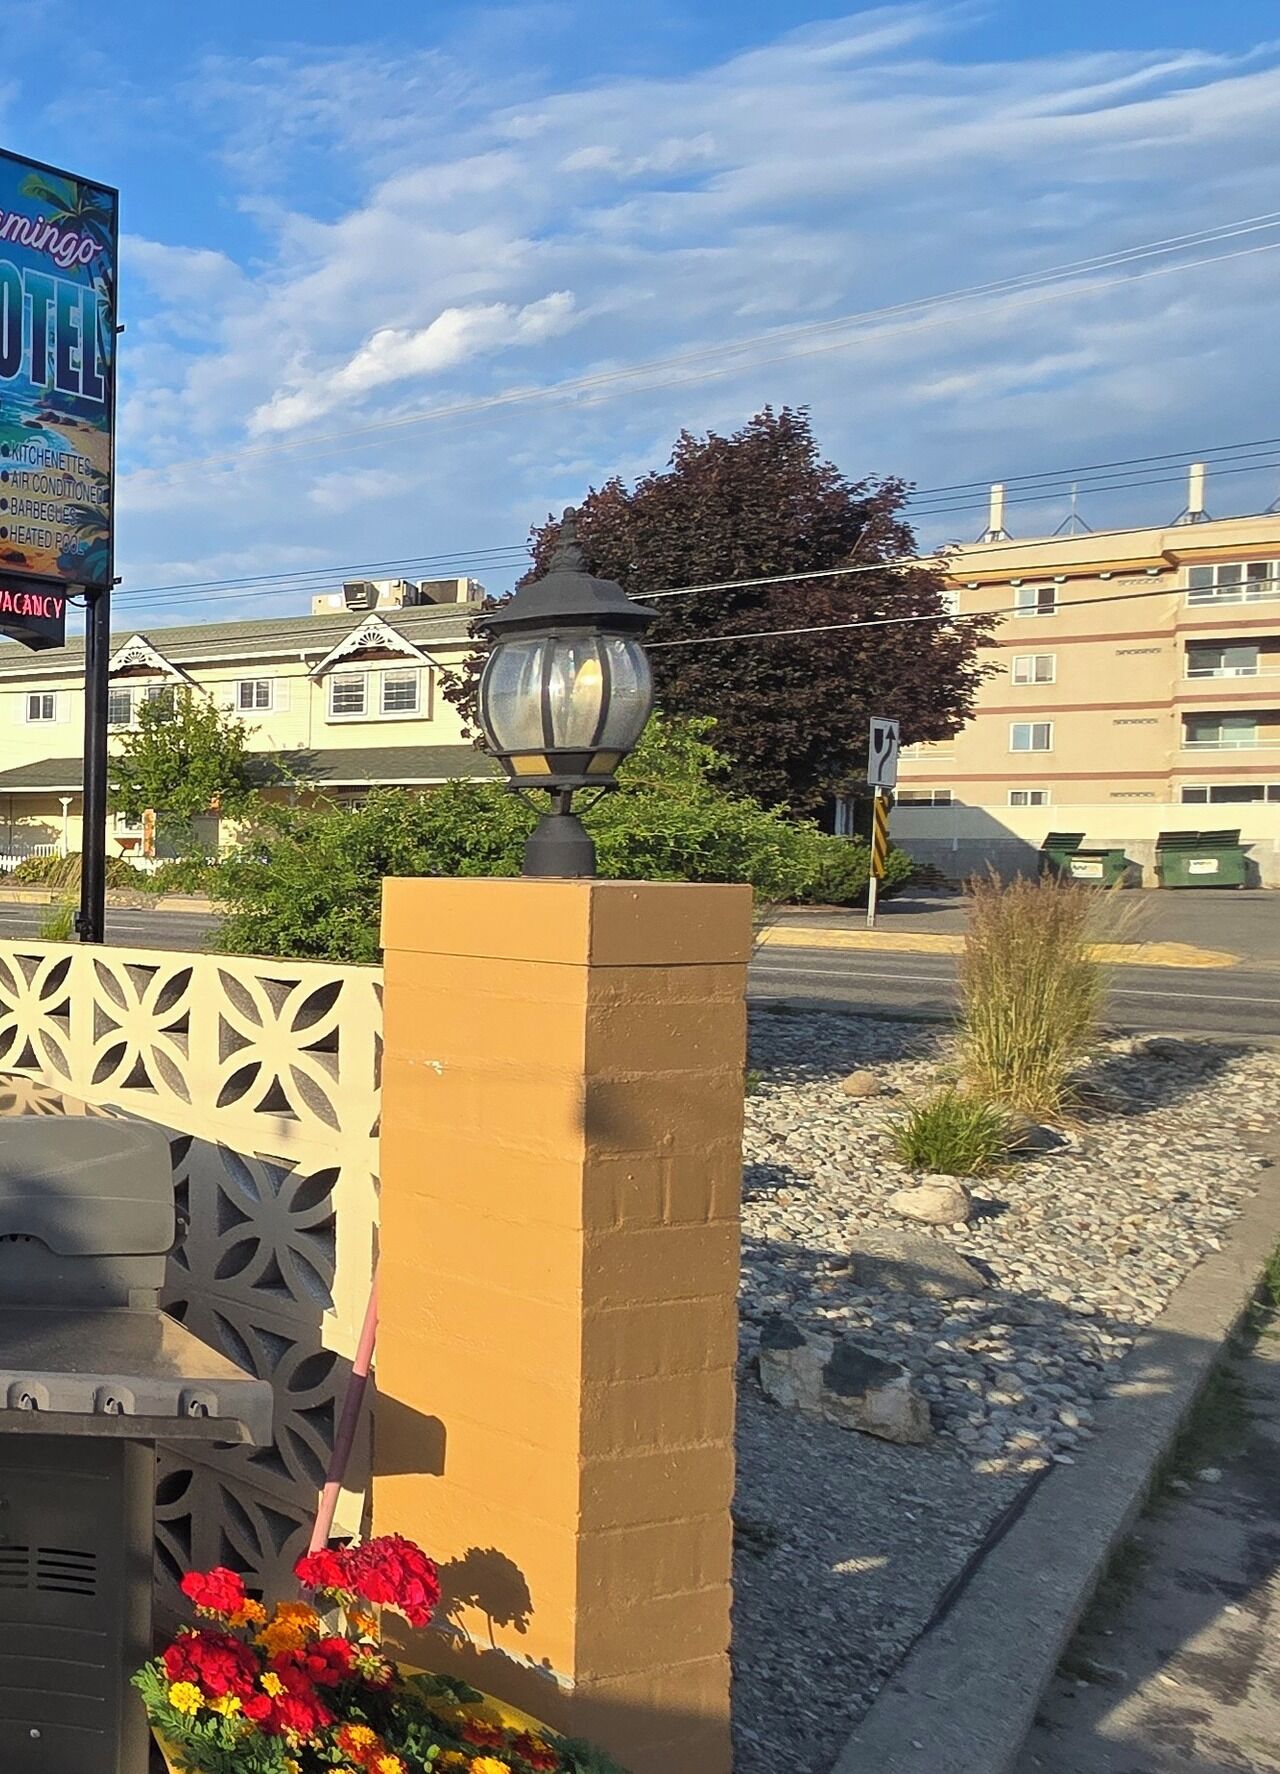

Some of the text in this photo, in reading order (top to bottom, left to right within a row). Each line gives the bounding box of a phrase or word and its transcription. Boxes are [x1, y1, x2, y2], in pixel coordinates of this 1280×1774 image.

[11, 443, 92, 476] KITCHENETTES
[11, 470, 104, 505] AIR CONDITIONED
[9, 524, 85, 556] HEATED POOL
